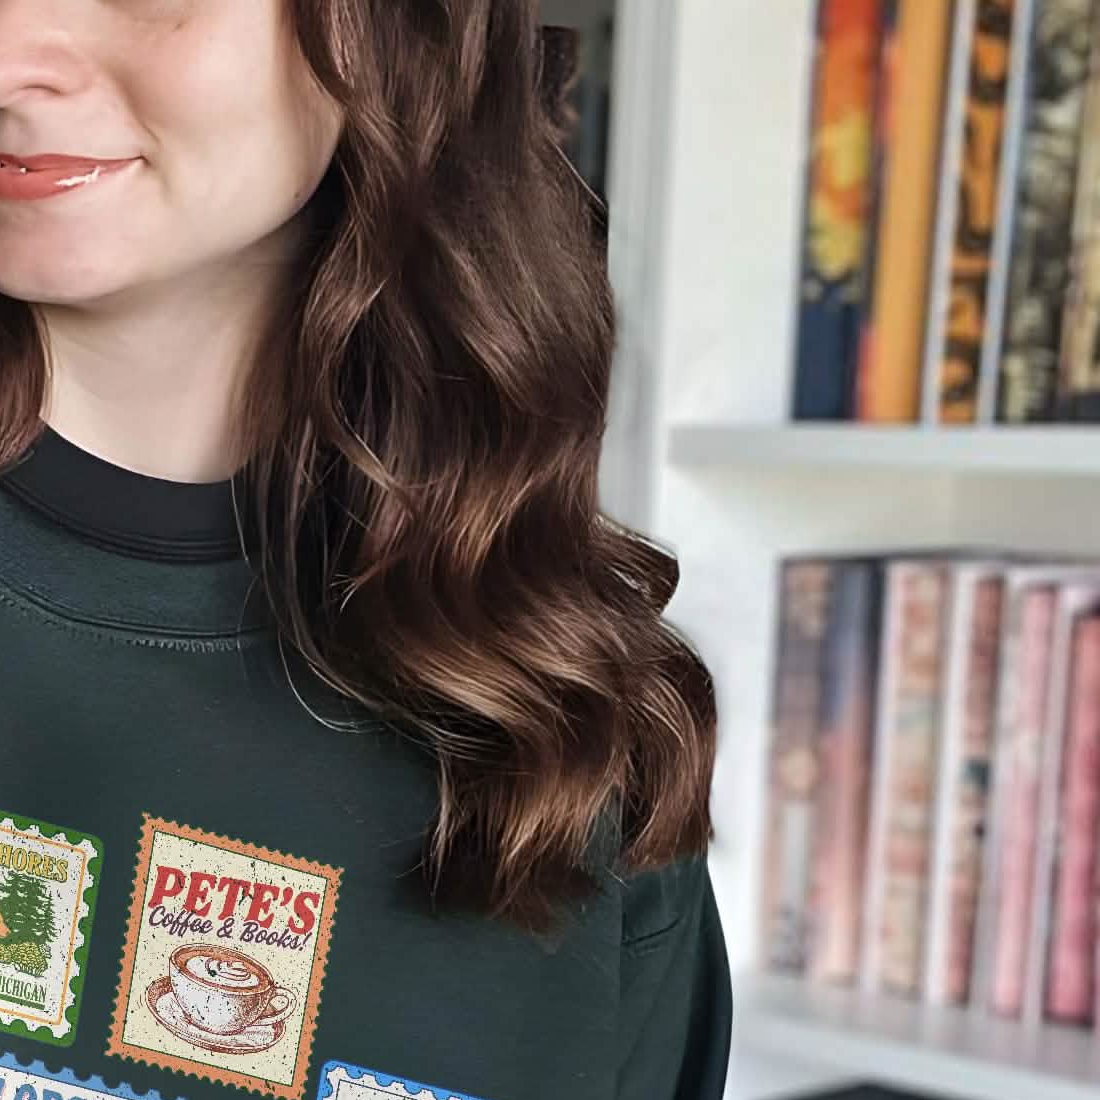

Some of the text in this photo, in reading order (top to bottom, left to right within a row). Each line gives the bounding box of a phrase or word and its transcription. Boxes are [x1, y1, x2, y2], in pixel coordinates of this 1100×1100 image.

[148, 866, 320, 934] PETE'S
[149, 906, 312, 951] Coffee & Books!
